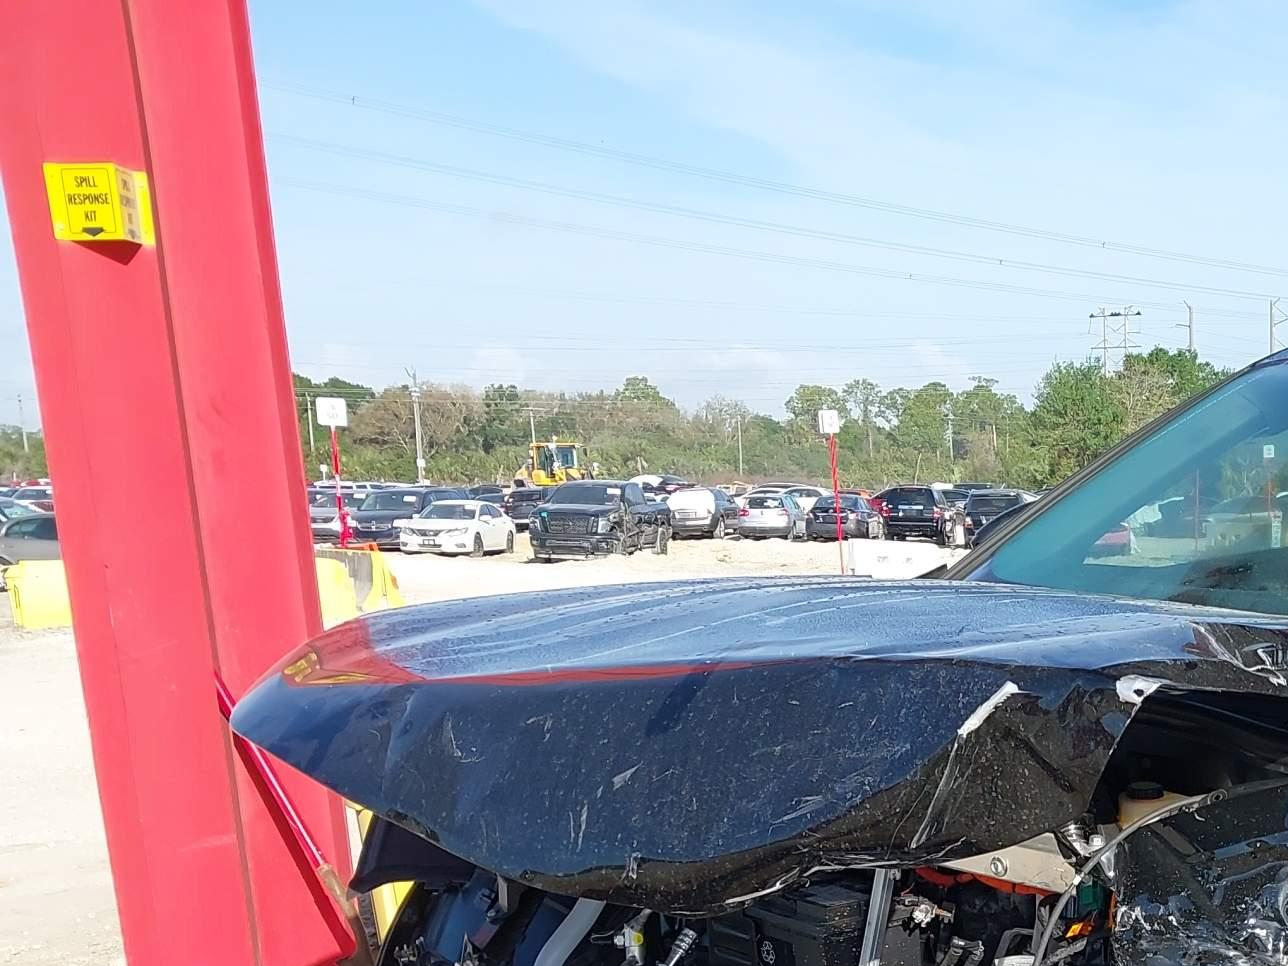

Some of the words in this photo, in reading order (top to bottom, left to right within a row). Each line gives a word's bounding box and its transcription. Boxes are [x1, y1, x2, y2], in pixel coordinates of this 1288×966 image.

[73, 176, 98, 188] SPILL
[67, 193, 110, 206] RESPONSE
[84, 211, 97, 222] KIT
